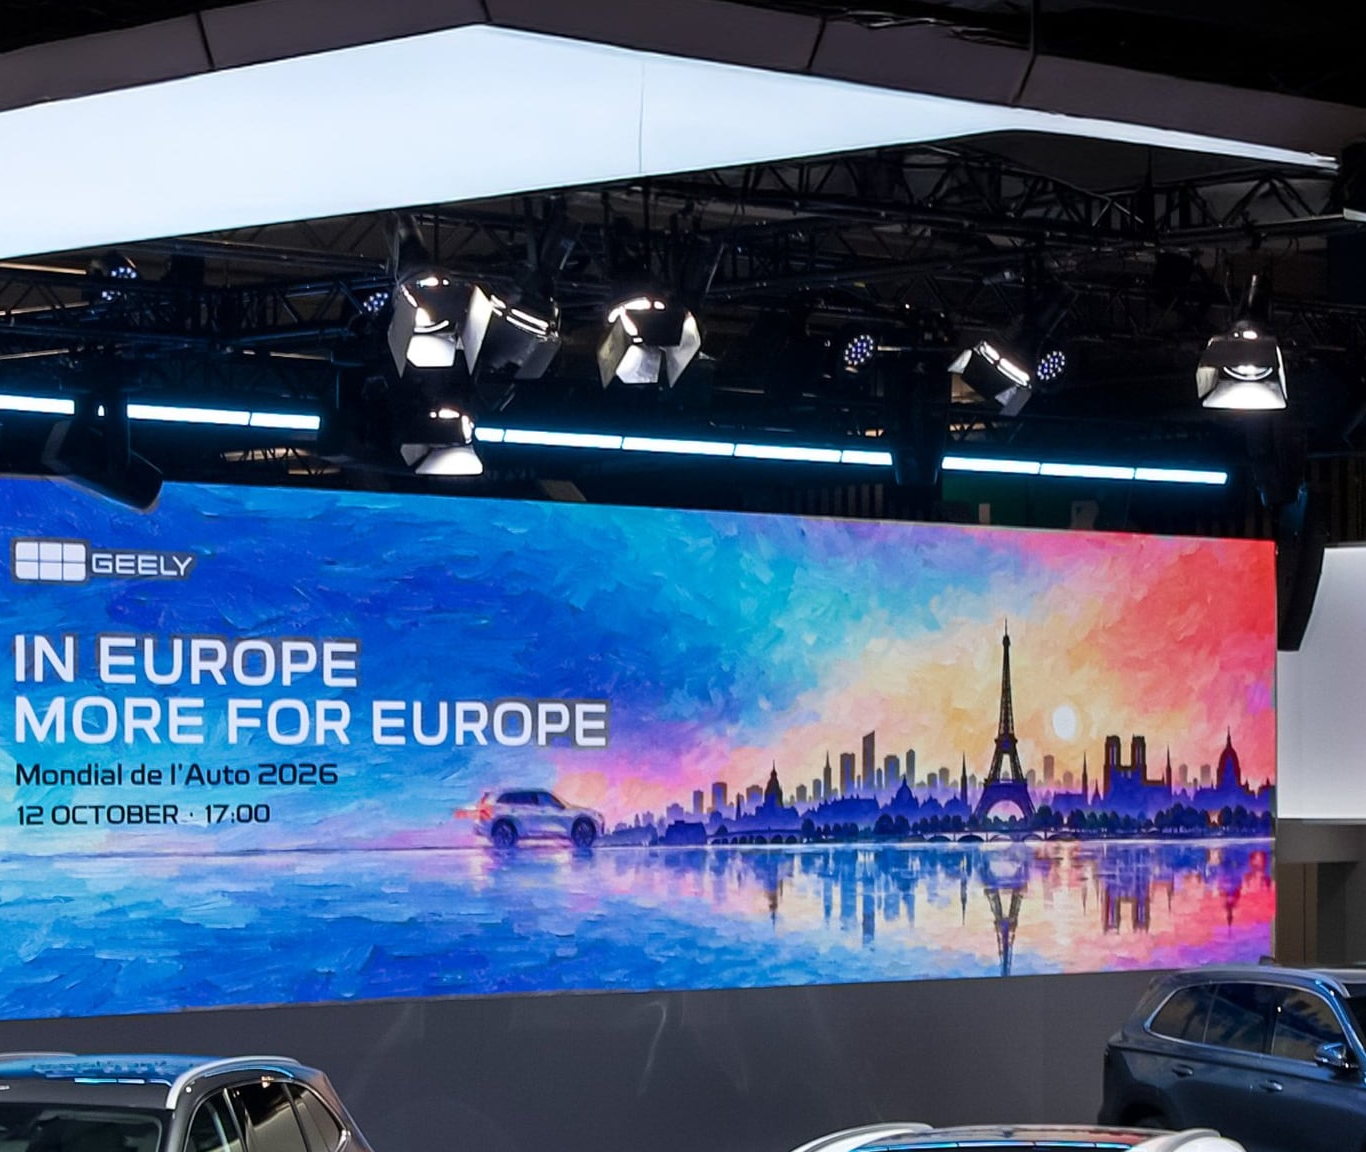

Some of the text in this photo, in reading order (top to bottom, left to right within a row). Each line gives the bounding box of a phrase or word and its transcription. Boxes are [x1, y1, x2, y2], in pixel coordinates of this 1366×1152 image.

[91, 553, 192, 576] GEELY
[15, 634, 358, 688] IN EUROPE
[15, 696, 608, 747] MORE FOR EUROPE
[15, 763, 339, 786] Mondial de l'Auto 2026
[17, 805, 44, 826] 12
[51, 805, 179, 826] OCTOBER
[205, 804, 271, 824] 17:00
